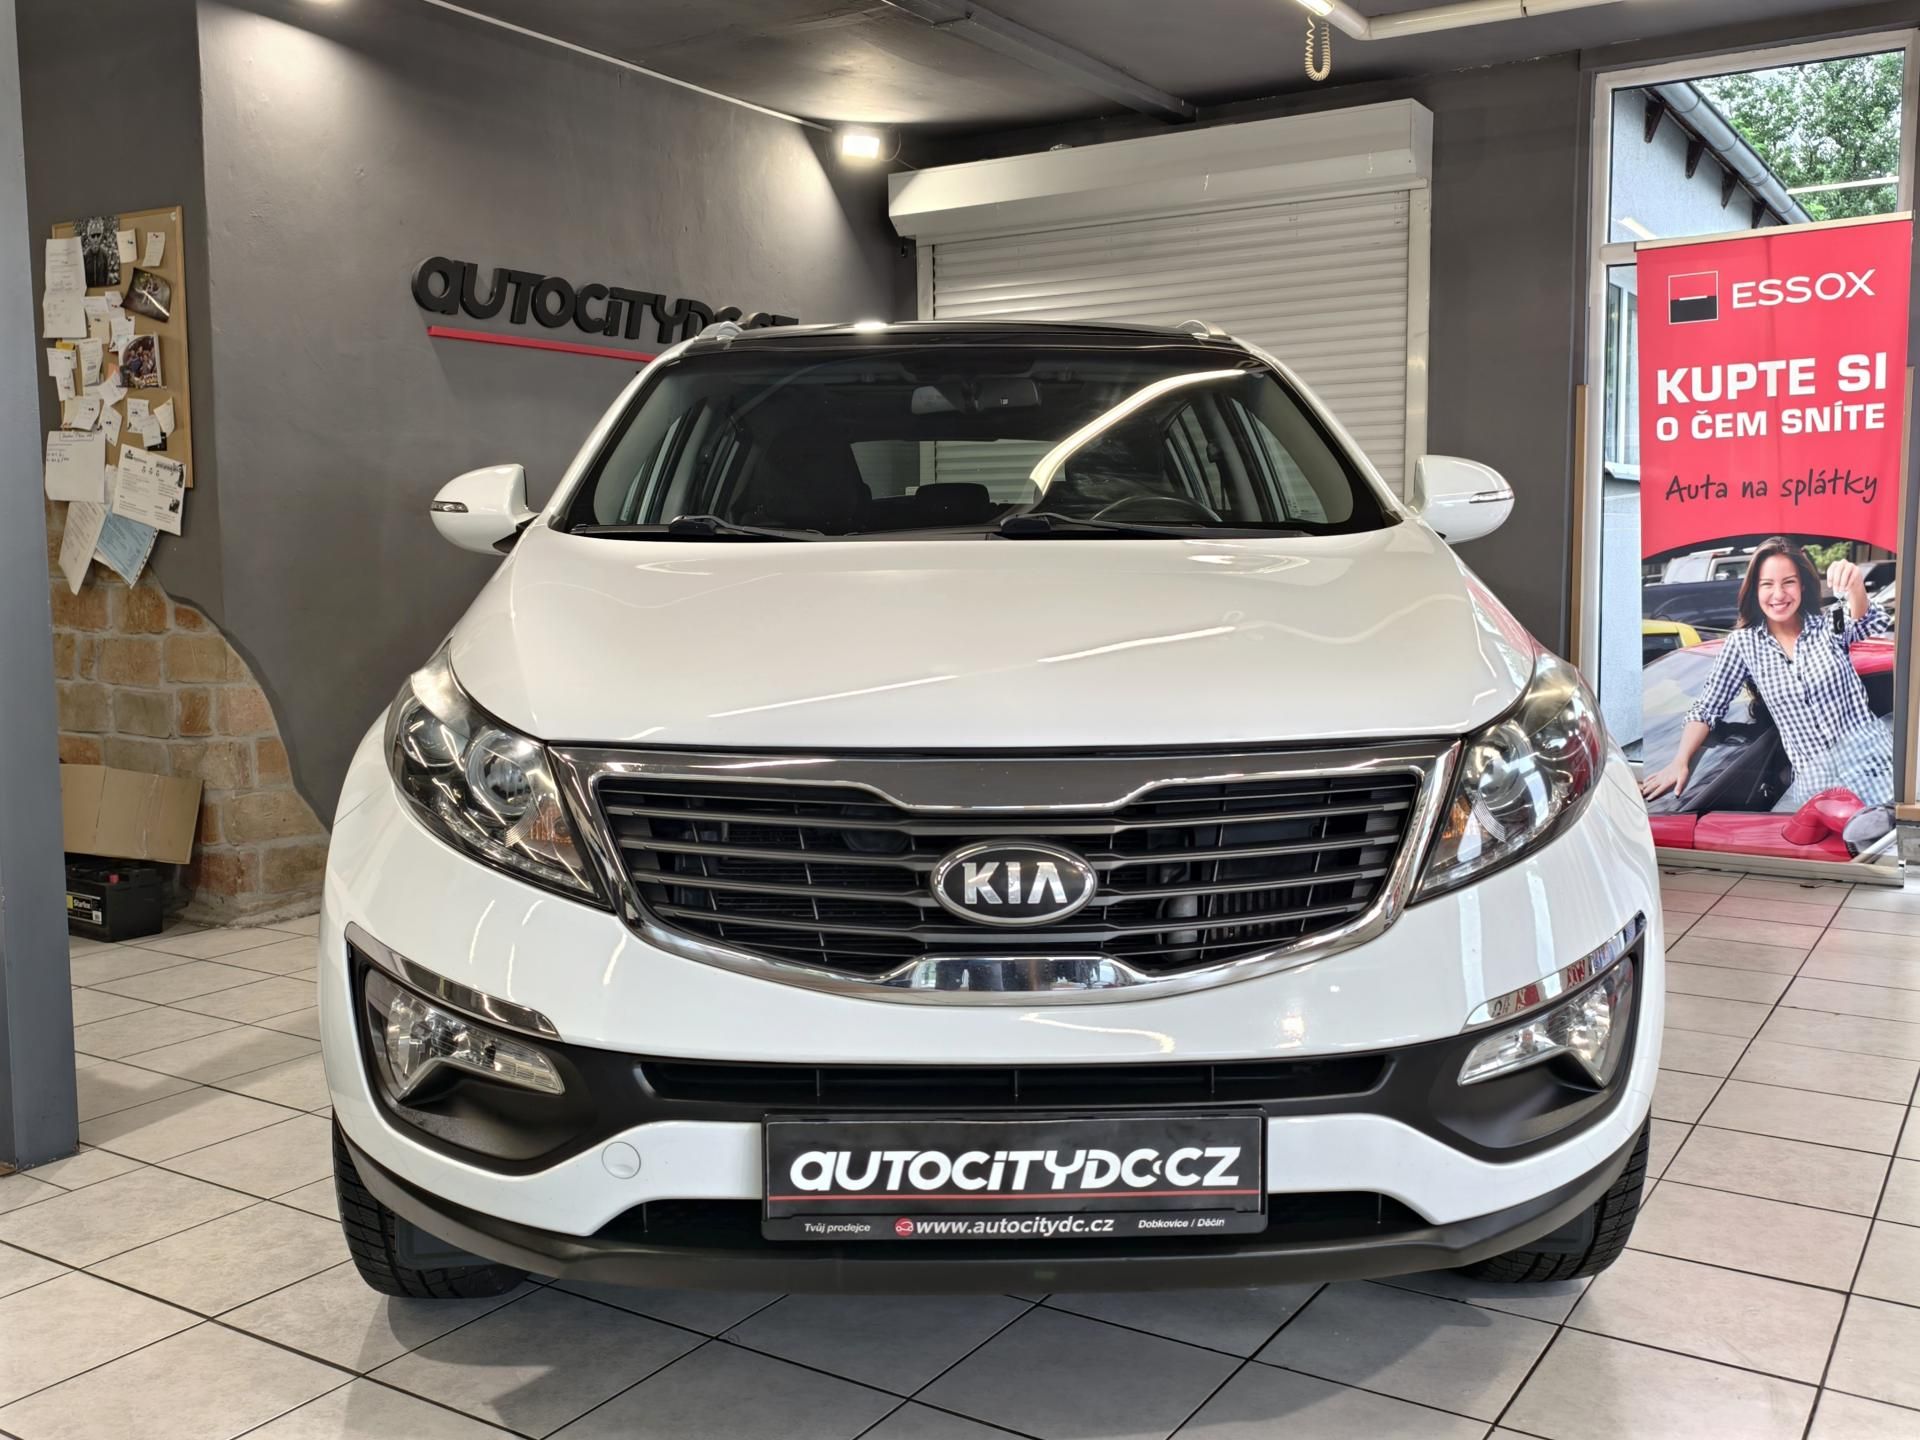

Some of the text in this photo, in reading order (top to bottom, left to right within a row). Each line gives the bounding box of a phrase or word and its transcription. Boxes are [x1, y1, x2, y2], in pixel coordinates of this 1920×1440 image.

[1732, 269, 1876, 309] ESSOX
[1657, 352, 1887, 405] KUPTE SI
[1656, 400, 1885, 442] O ČEM SNÍTE
[1665, 468, 1878, 506] Auta na splátky
[962, 862, 1068, 904] KIA
[804, 1223, 871, 1233] Tvůj prodejce
[916, 1216, 1115, 1236] www.autocitydc.cz
[1138, 1219, 1188, 1229] Dobkovice
[1197, 1218, 1225, 1228] Děčín
